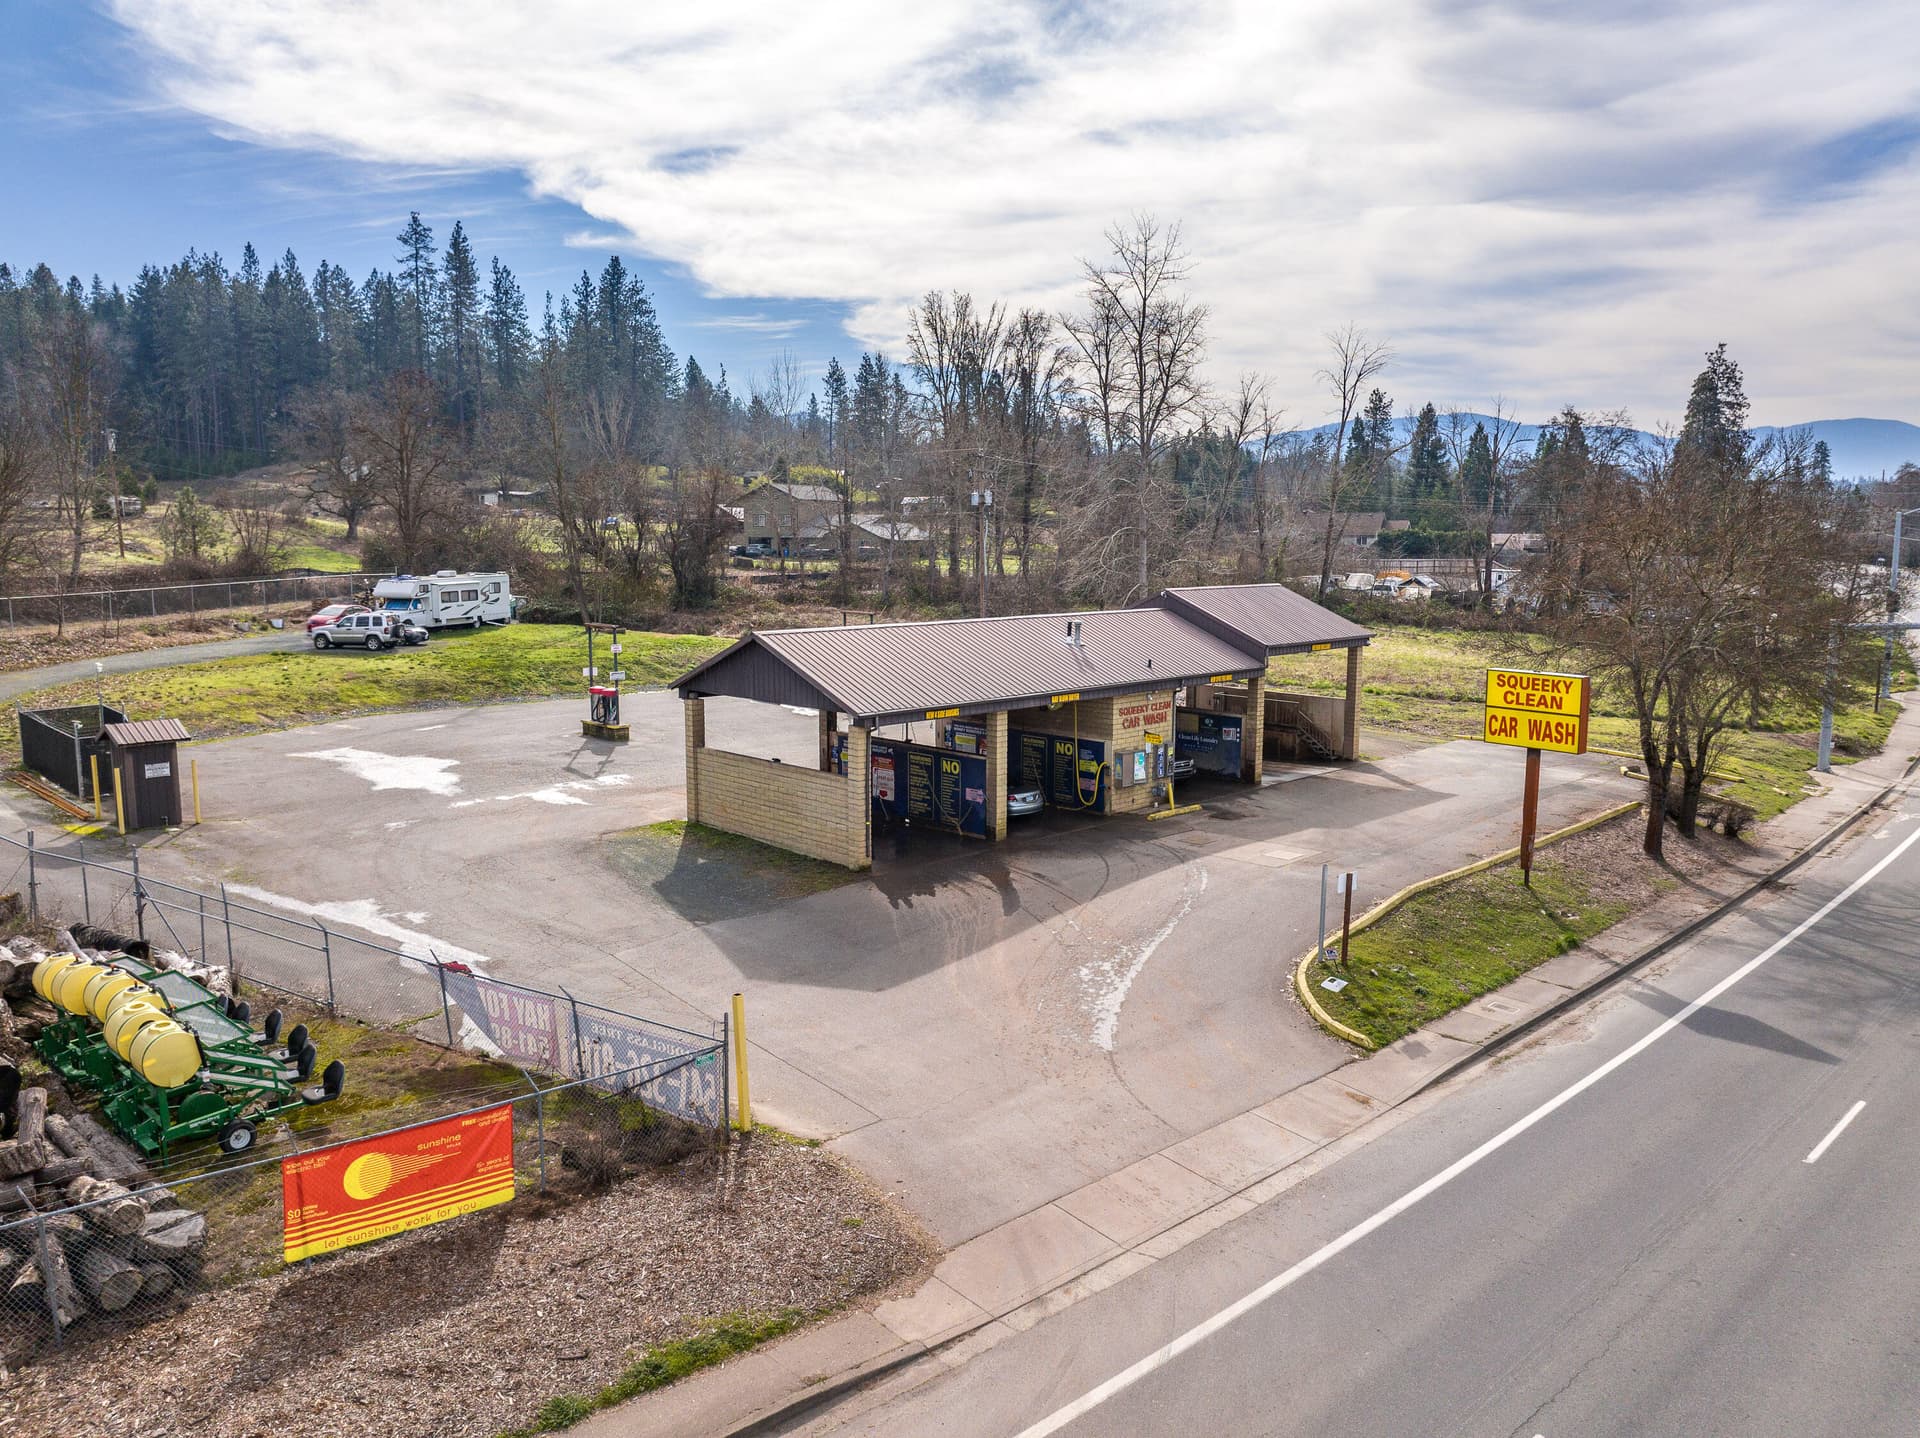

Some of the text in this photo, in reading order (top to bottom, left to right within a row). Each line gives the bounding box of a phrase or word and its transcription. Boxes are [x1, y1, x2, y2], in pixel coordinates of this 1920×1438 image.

[1496, 673, 1574, 694] SQUEEKY
[1119, 700, 1172, 717] SQUEEKY CLEAN
[1503, 690, 1563, 710] CLEAN
[1122, 711, 1168, 729] CAR WASH
[1488, 714, 1576, 746] CAR WASH
[1056, 742, 1073, 756] NO
[942, 760, 960, 774] NO
[417, 1134, 461, 1151] sunshine
[324, 1201, 477, 1249] let sunshine work for you
